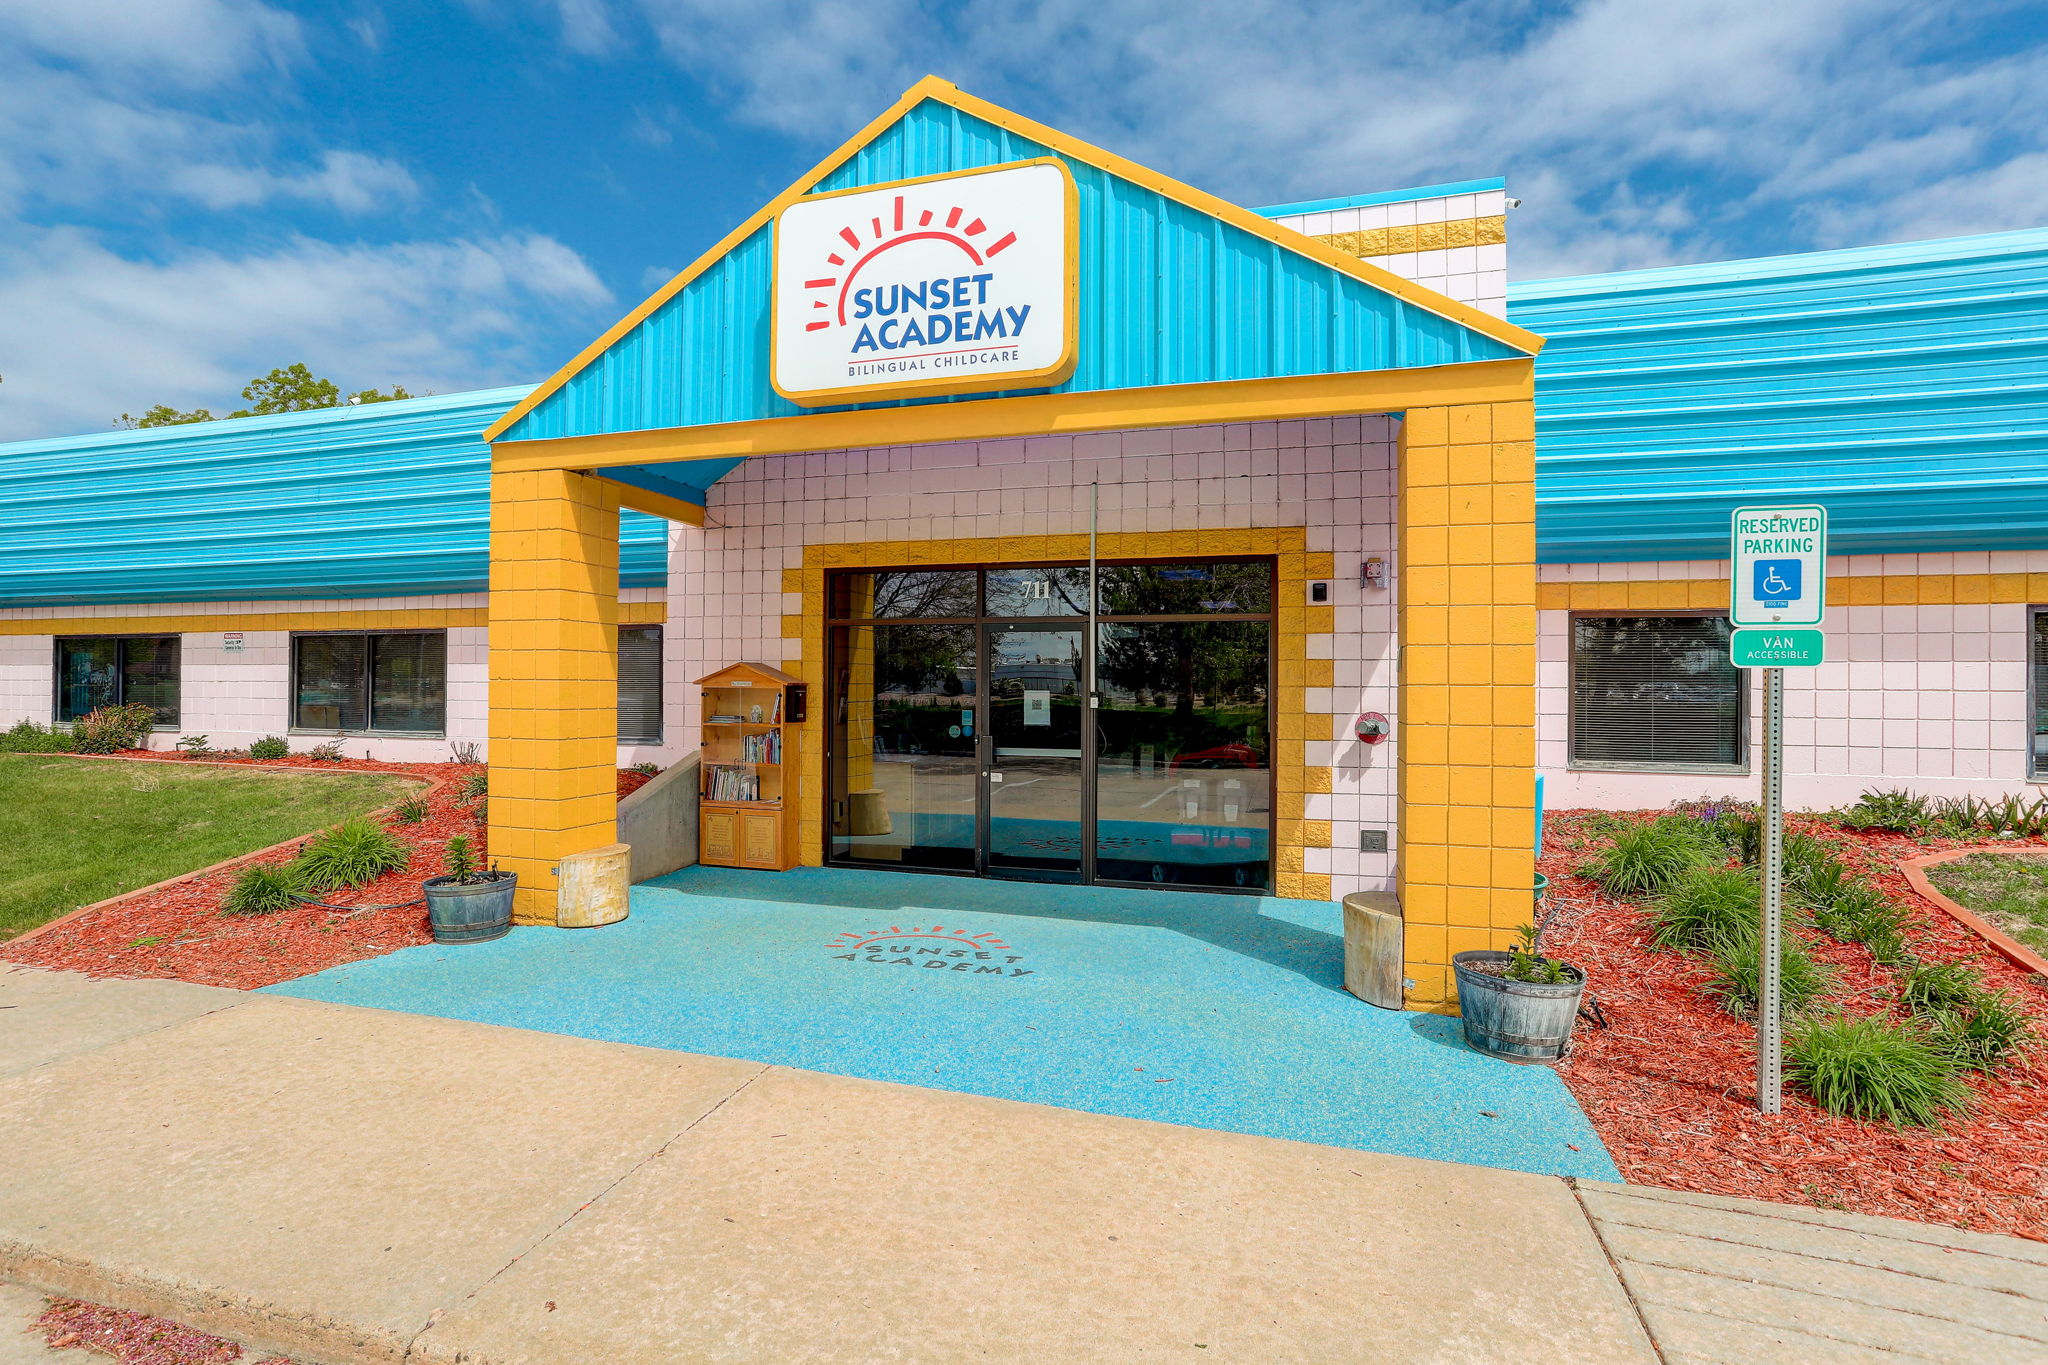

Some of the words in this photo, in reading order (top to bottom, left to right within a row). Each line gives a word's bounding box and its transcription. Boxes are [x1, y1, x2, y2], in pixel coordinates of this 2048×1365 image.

[853, 273, 993, 319] SUNSET
[851, 304, 1031, 353] ACADEMY
[848, 359, 926, 376] BILINGUAL
[934, 350, 1019, 368] CHILDCARE
[1739, 517, 1819, 534] RESERVED
[1744, 538, 1813, 554] PARKING
[1021, 580, 1050, 599] 711
[1762, 637, 1794, 649] VAN
[1747, 651, 1809, 659] ACCESSIBLE
[864, 945, 1024, 964] SUNSET
[832, 953, 1036, 977] ACADEMY
